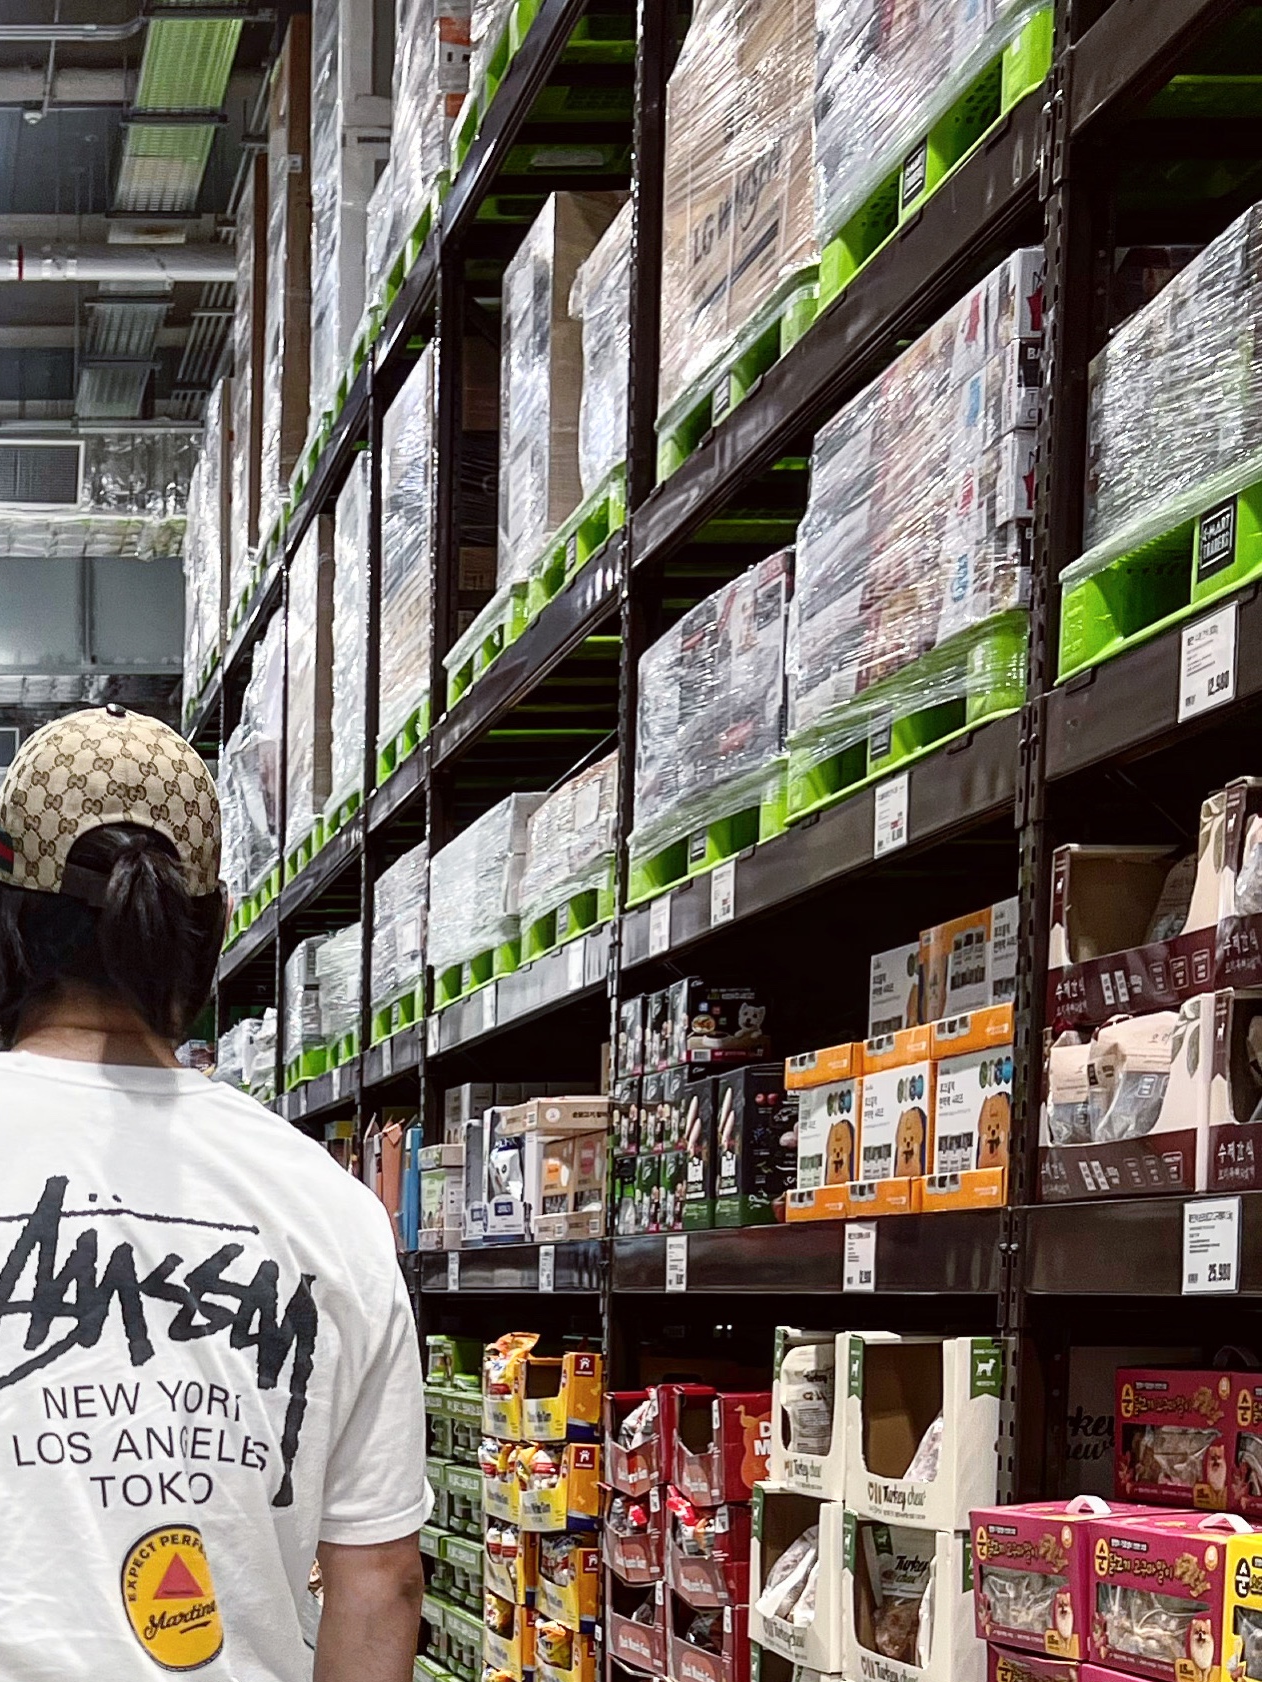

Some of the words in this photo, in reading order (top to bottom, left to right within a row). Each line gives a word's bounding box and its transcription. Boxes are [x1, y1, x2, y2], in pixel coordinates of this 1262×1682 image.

[1217, 1139, 1255, 1163] 수제간식
[42, 1382, 140, 1420] NEW
[12, 1430, 93, 1466] LOS
[90, 1470, 214, 1509] TOKO
[883, 1484, 907, 1511] Turkey
[127, 1541, 157, 1602] EXPECT
